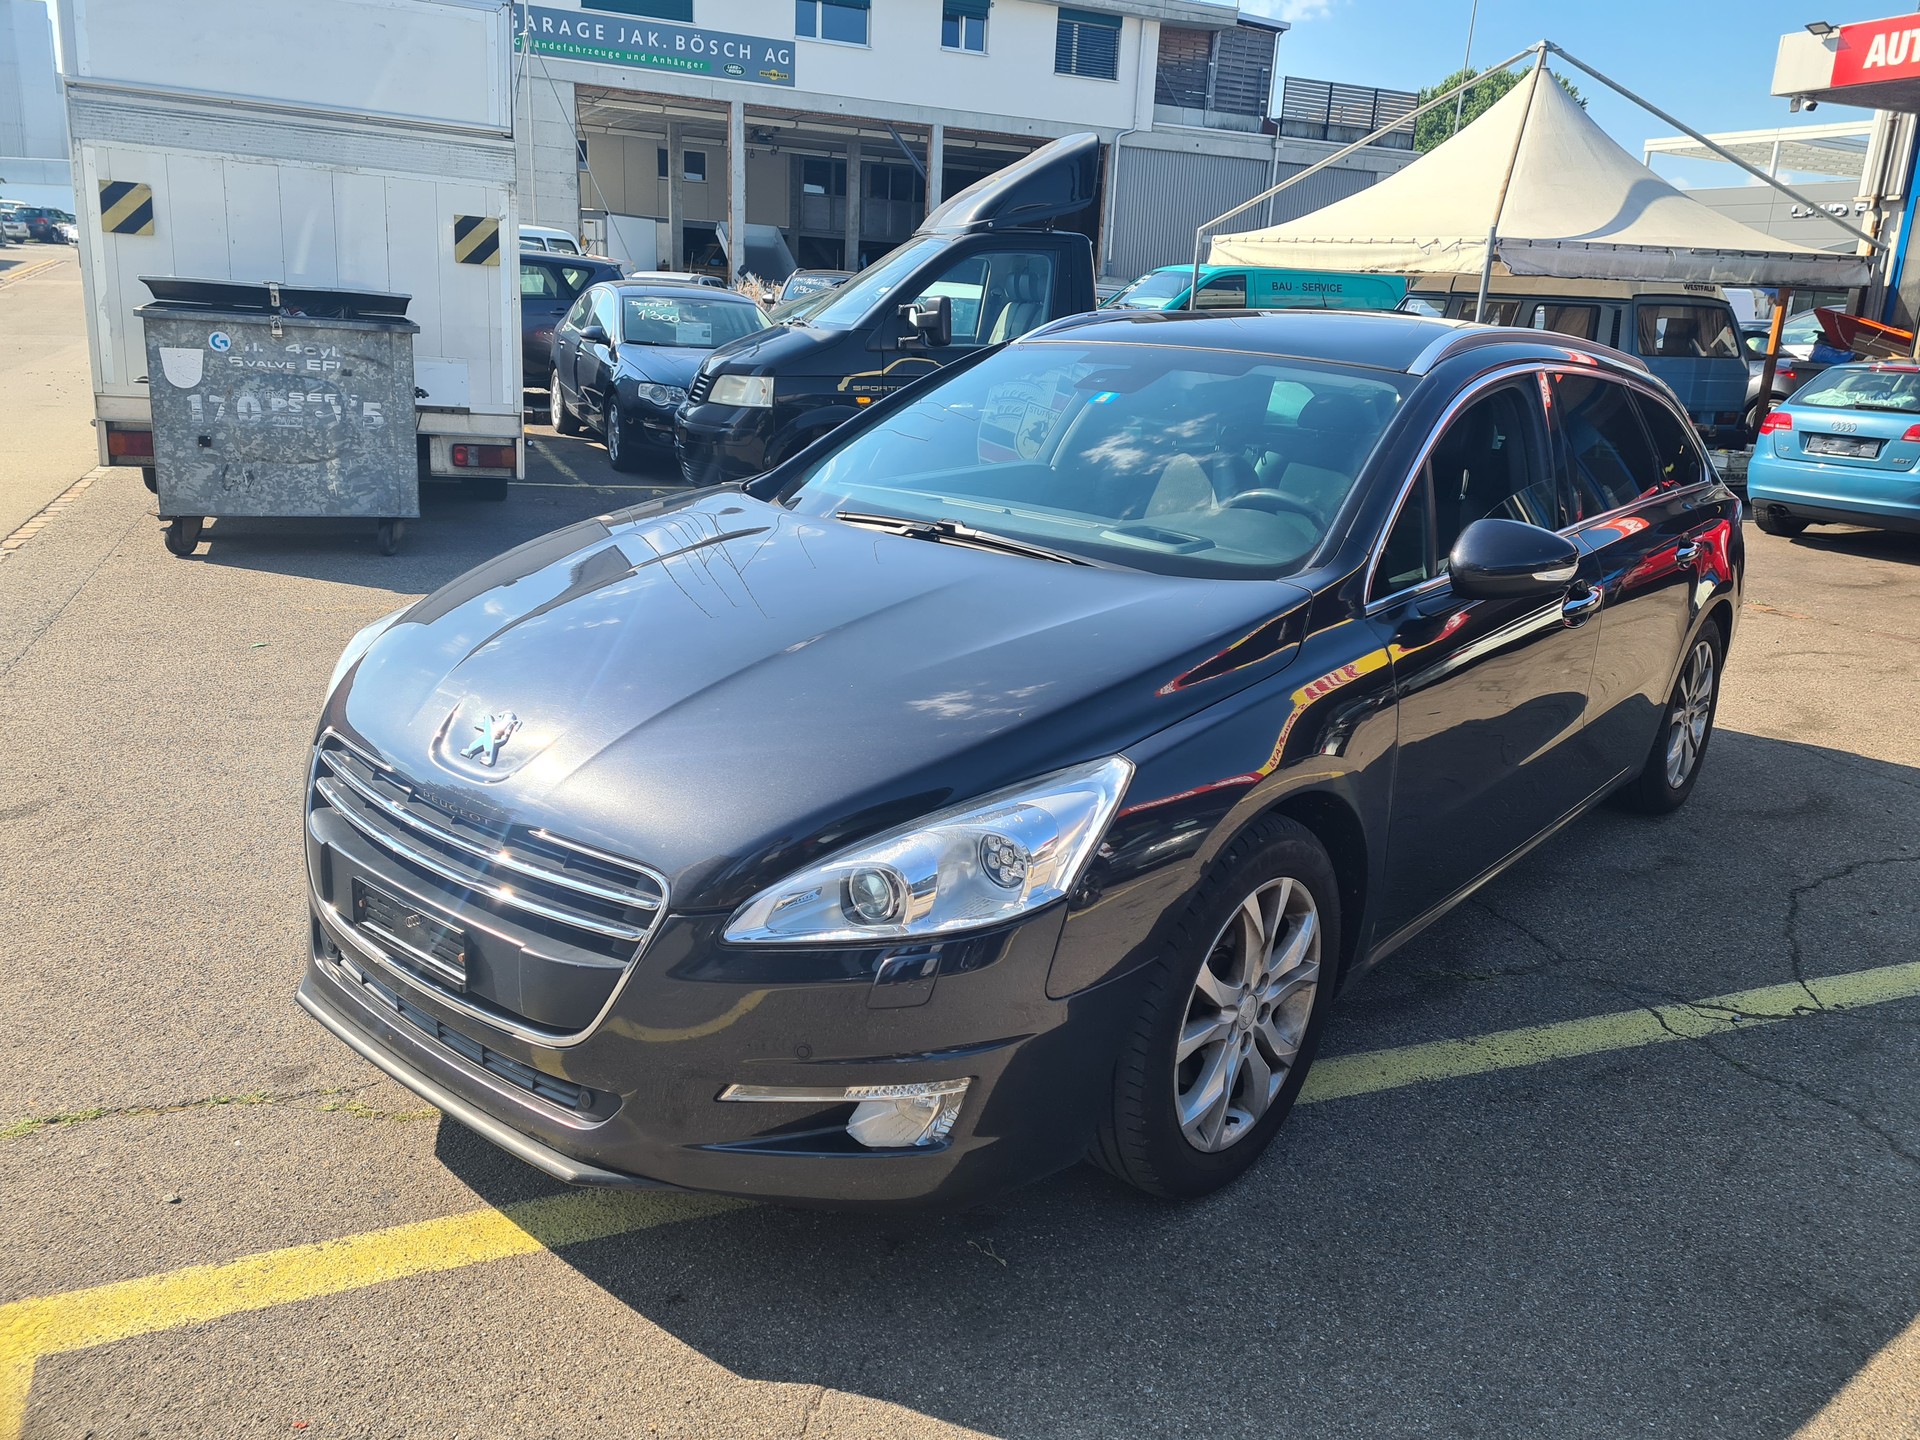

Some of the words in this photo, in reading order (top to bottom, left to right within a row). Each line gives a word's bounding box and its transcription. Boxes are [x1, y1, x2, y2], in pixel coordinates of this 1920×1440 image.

[514, 37, 620, 60] Gländefahrzeuge
[627, 52, 646, 62] und
[652, 55, 705, 70] Anhänger
[618, 28, 667, 49] JAK.
[675, 34, 751, 60] BÖSCH
[764, 48, 790, 65] AG
[1272, 281, 1293, 291] BAU
[1302, 283, 1343, 293] SERVICE
[1683, 283, 1716, 292] WESTFALIA
